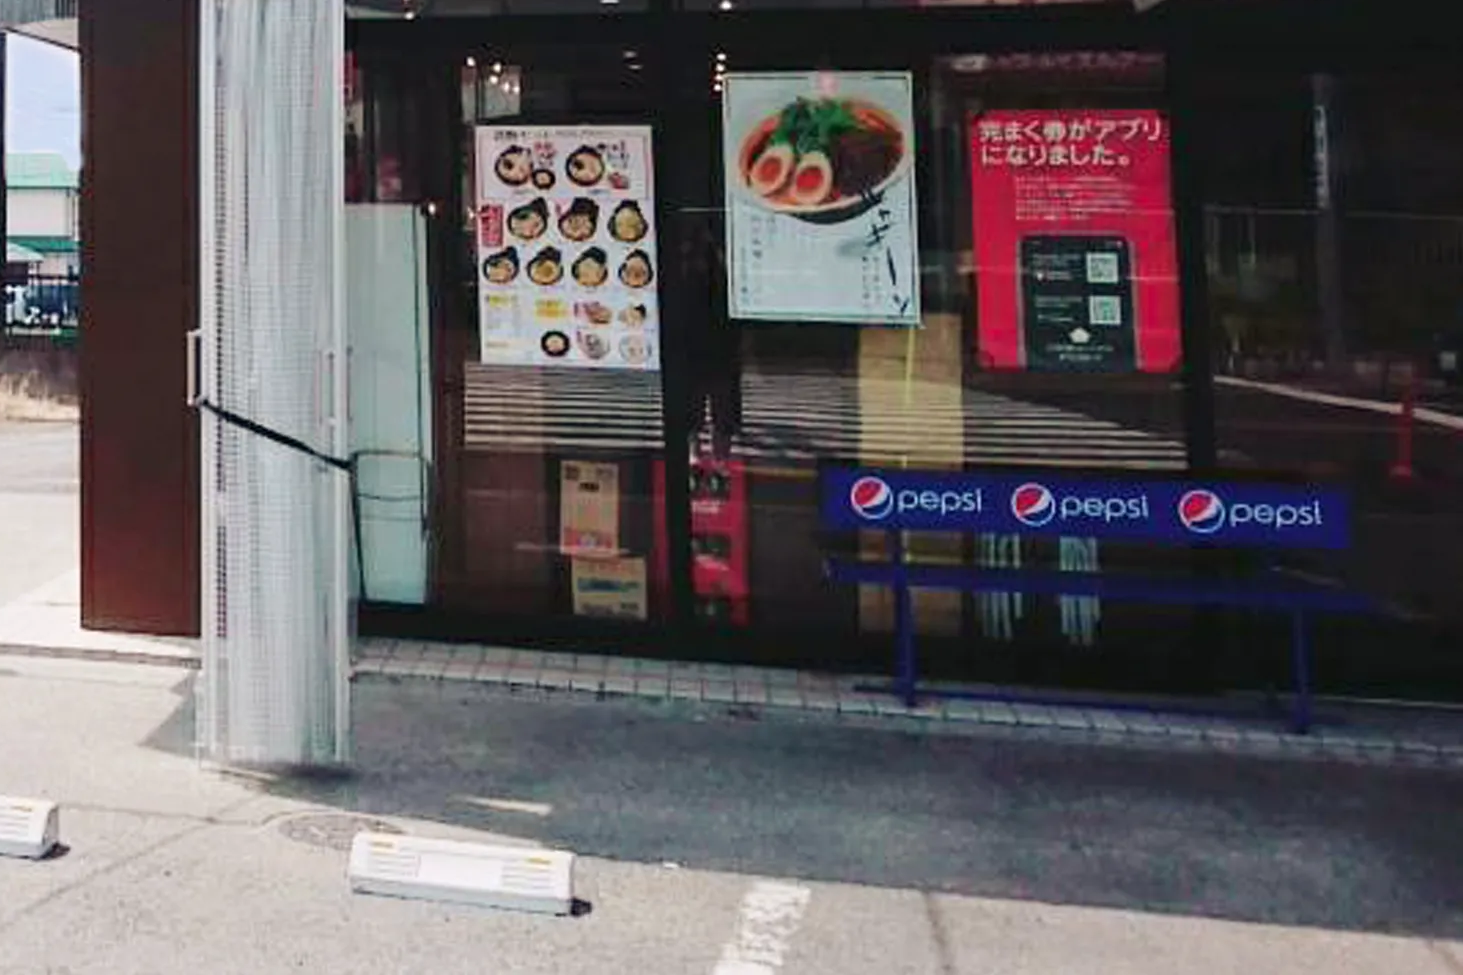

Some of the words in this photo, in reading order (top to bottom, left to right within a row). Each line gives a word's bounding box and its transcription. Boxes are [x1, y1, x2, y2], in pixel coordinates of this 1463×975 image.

[981, 143, 1131, 166] になりました。
[896, 487, 983, 516] pepsi
[1060, 494, 1149, 523] pepsi
[1229, 499, 1323, 529] pepsi
